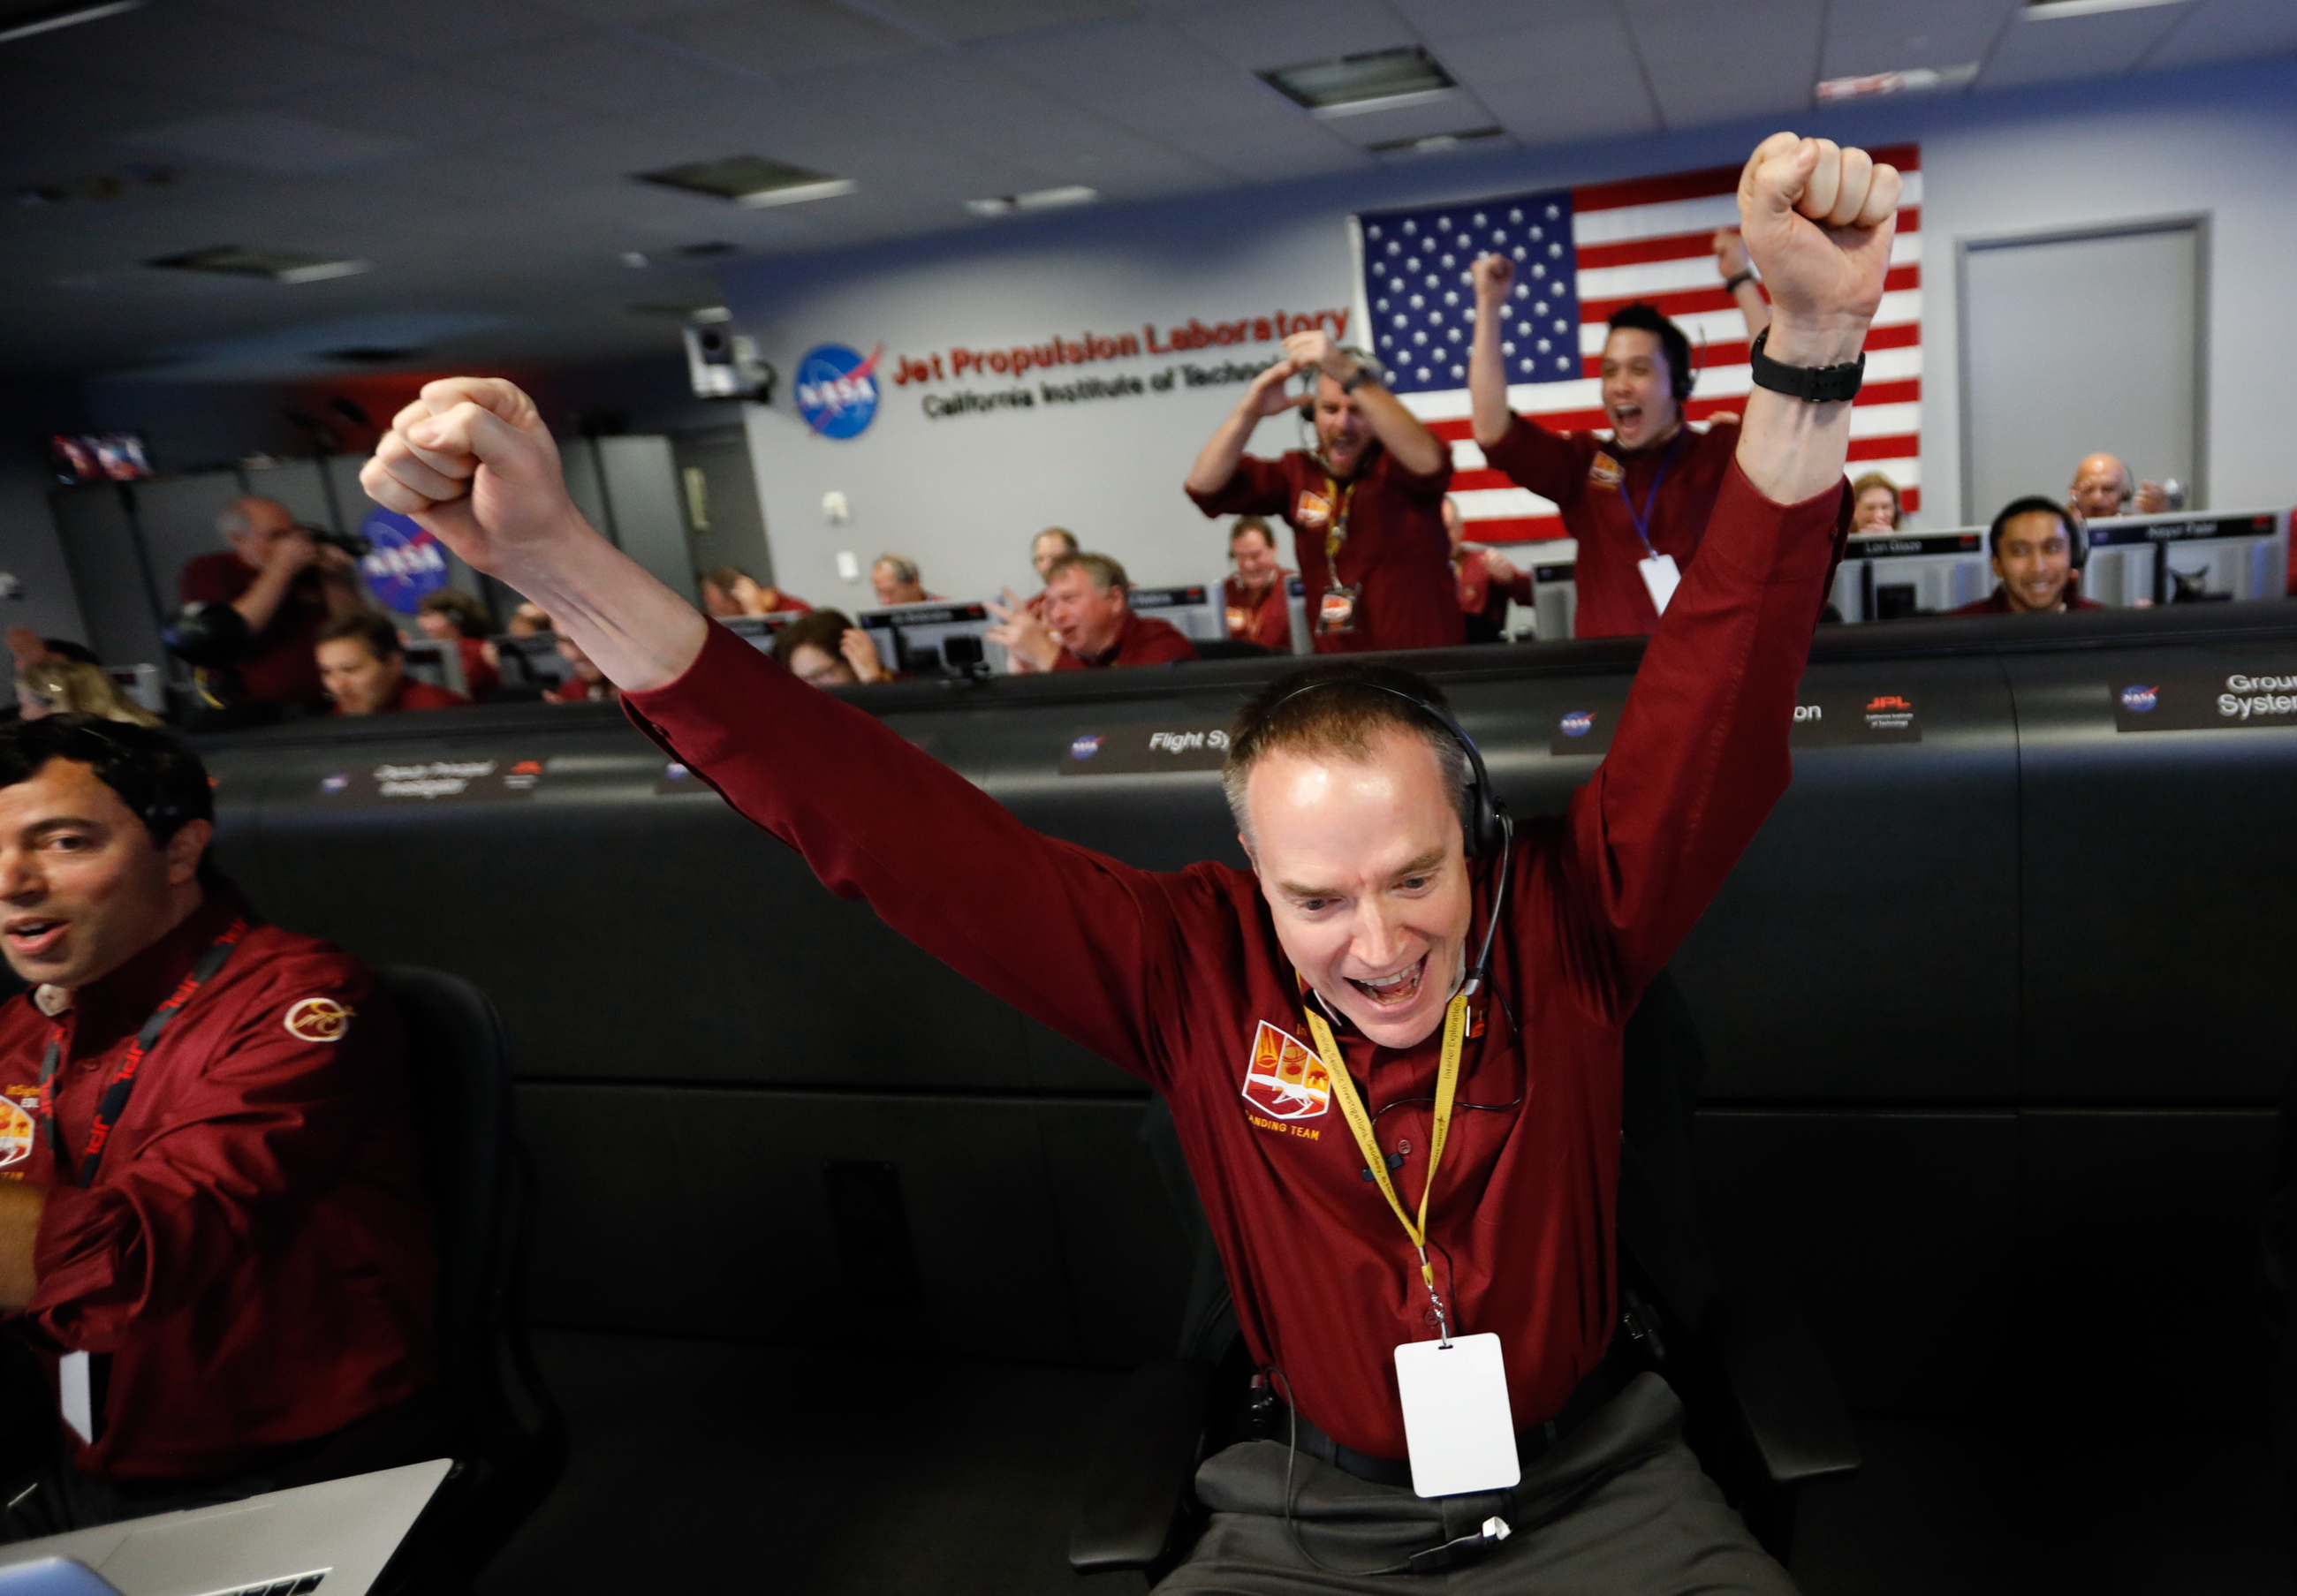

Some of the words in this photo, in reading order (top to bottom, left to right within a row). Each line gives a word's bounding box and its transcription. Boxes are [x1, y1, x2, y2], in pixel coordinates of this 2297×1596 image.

[892, 354, 944, 386] Jet
[950, 329, 1139, 378] Propulsion
[1143, 306, 1350, 354] Laboratory
[798, 376, 876, 414] NASA
[922, 389, 1034, 419] California
[1040, 373, 1143, 404] Institute
[1150, 365, 1175, 392] of
[363, 542, 446, 578] NASA
[1793, 706, 1822, 722] on
[1867, 696, 1911, 710] JPL
[1149, 731, 1204, 754] Flight
[1207, 730, 1229, 751] Sy
[157, 972, 201, 1012] JPL
[1447, 1002, 1461, 1048] Exploration
[112, 1039, 145, 1084] JPL
[1246, 1112, 1287, 1133] ANDING
[1291, 1126, 1321, 1141] TEAM
